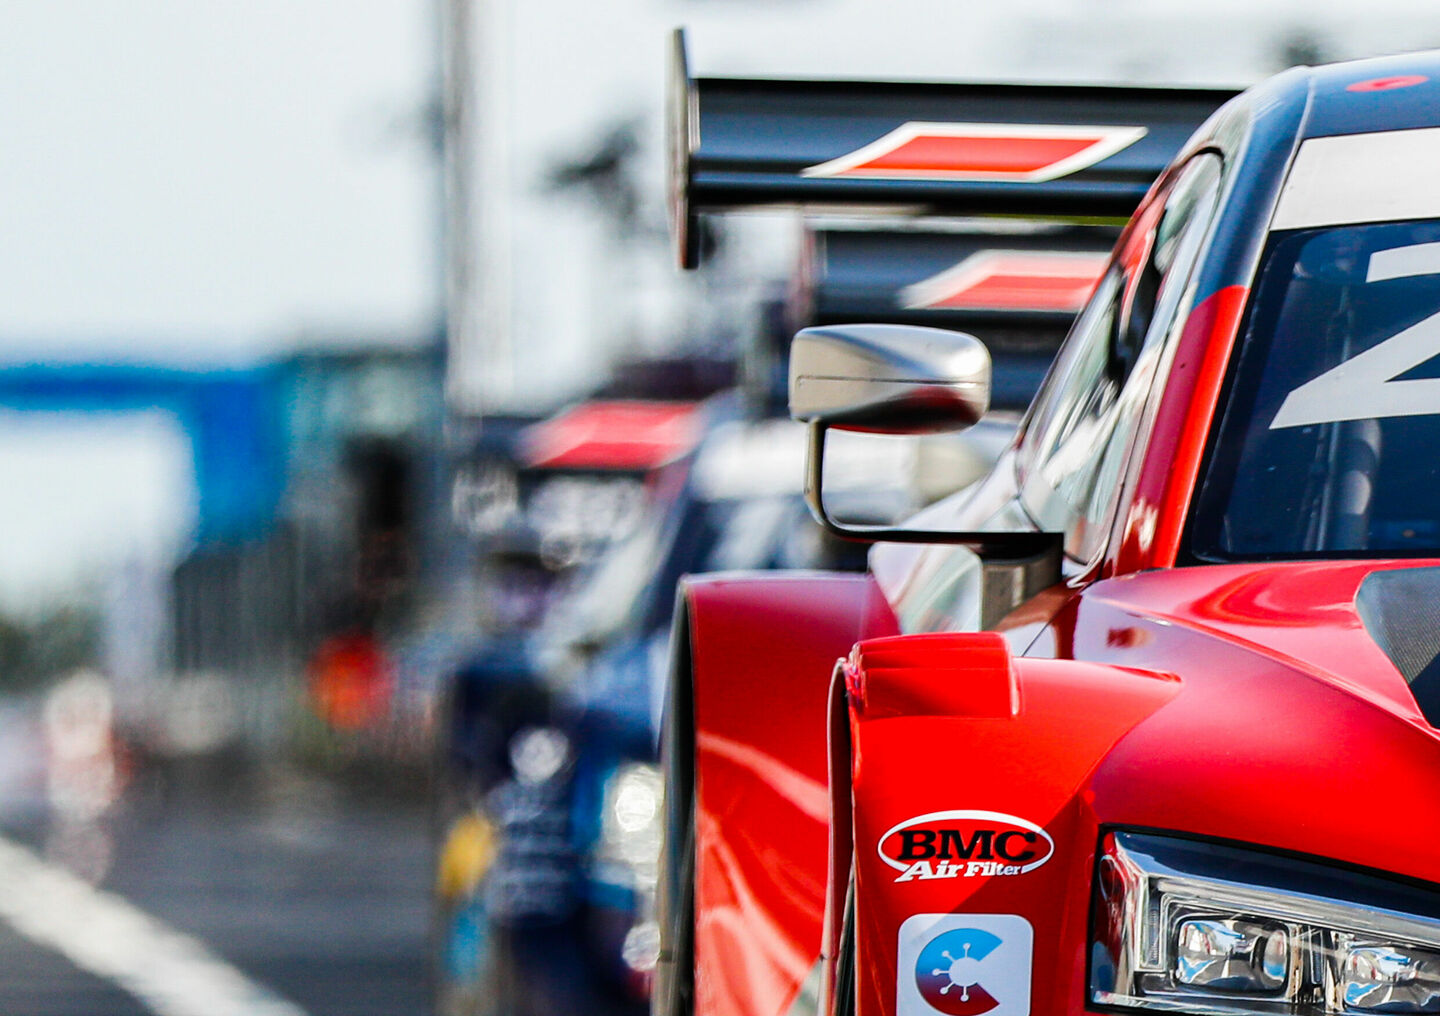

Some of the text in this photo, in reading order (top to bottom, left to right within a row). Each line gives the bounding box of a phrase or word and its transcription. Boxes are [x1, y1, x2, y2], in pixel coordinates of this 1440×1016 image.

[897, 829, 1037, 862] BMC
[893, 860, 1022, 883] Air Filter
